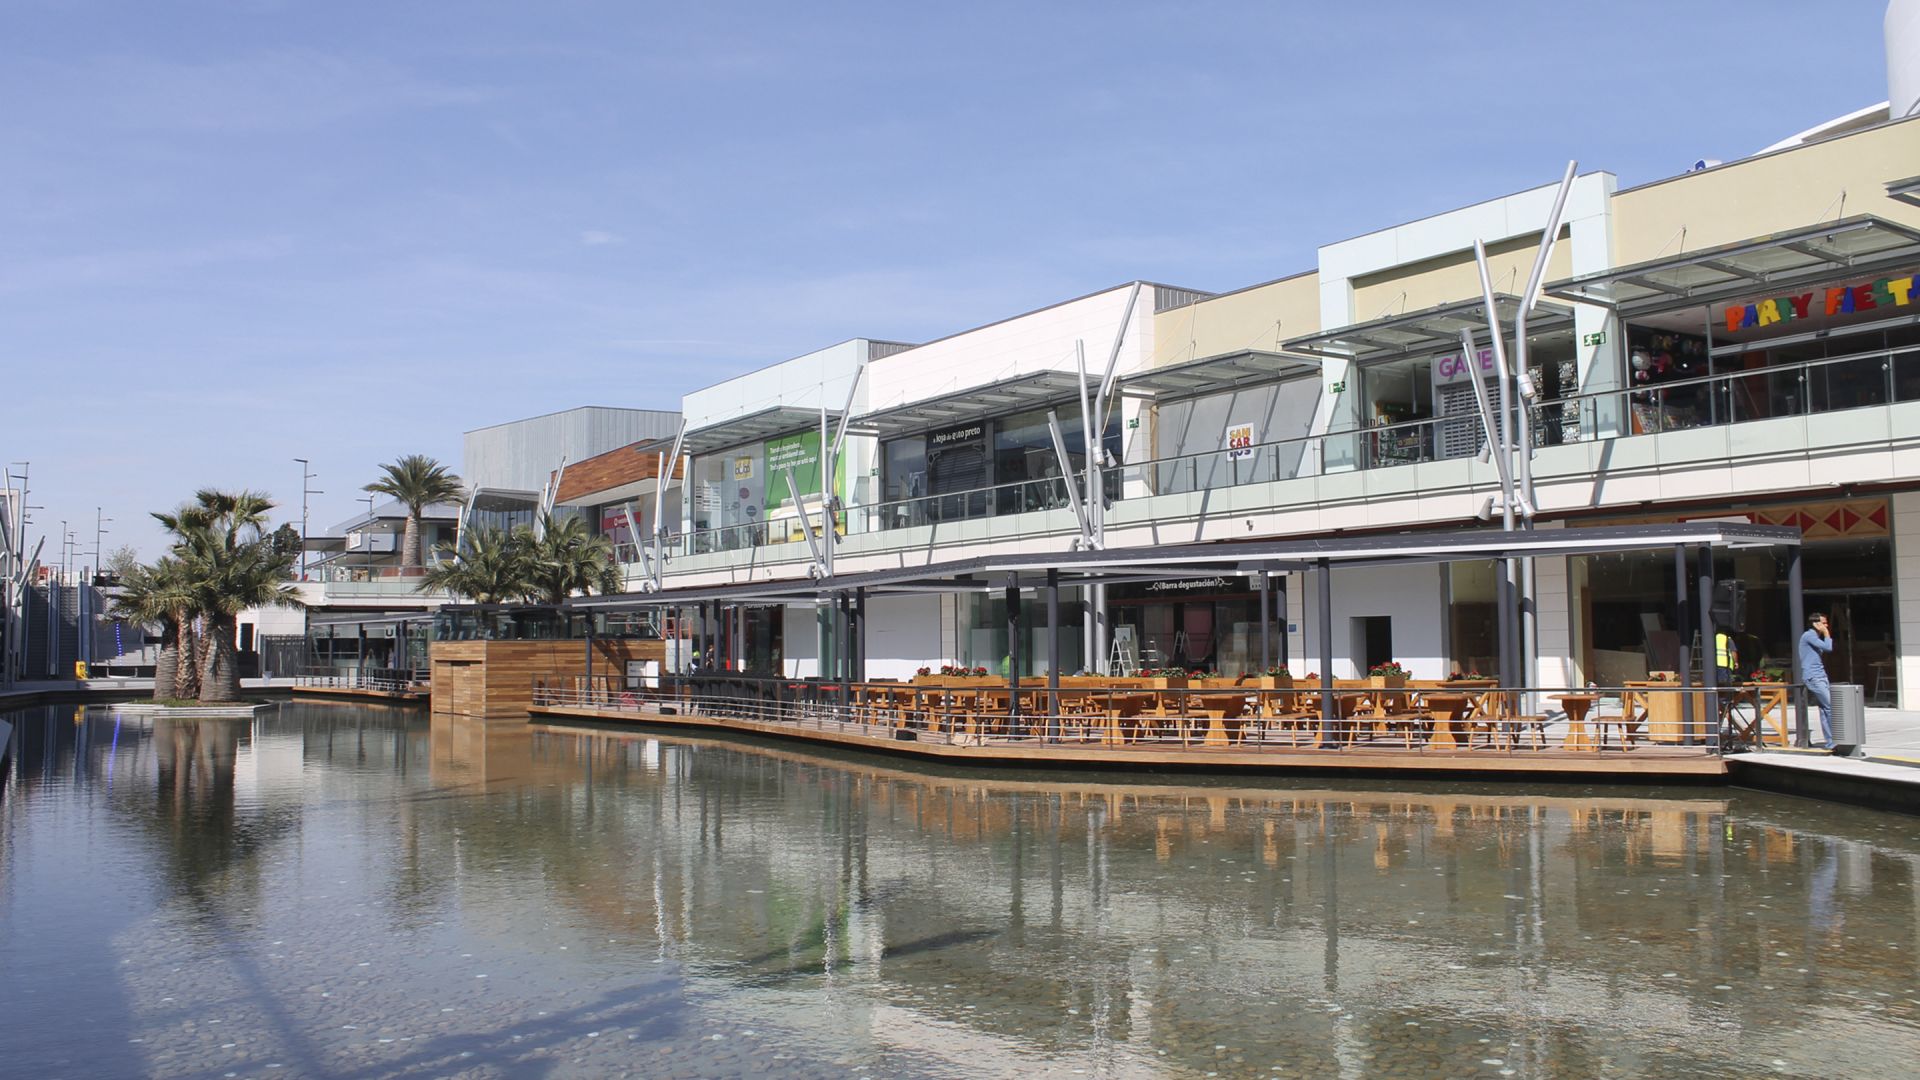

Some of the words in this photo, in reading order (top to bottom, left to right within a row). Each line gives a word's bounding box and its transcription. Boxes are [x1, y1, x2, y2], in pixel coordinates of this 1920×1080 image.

[1725, 293, 1813, 332] PARTY
[1439, 350, 1493, 377] GAE
[964, 427, 980, 440] preto
[1230, 427, 1250, 440] SAN
[1230, 436, 1250, 449] CAR
[1161, 582, 1178, 590] Barra
[1178, 580, 1215, 590] degustación
